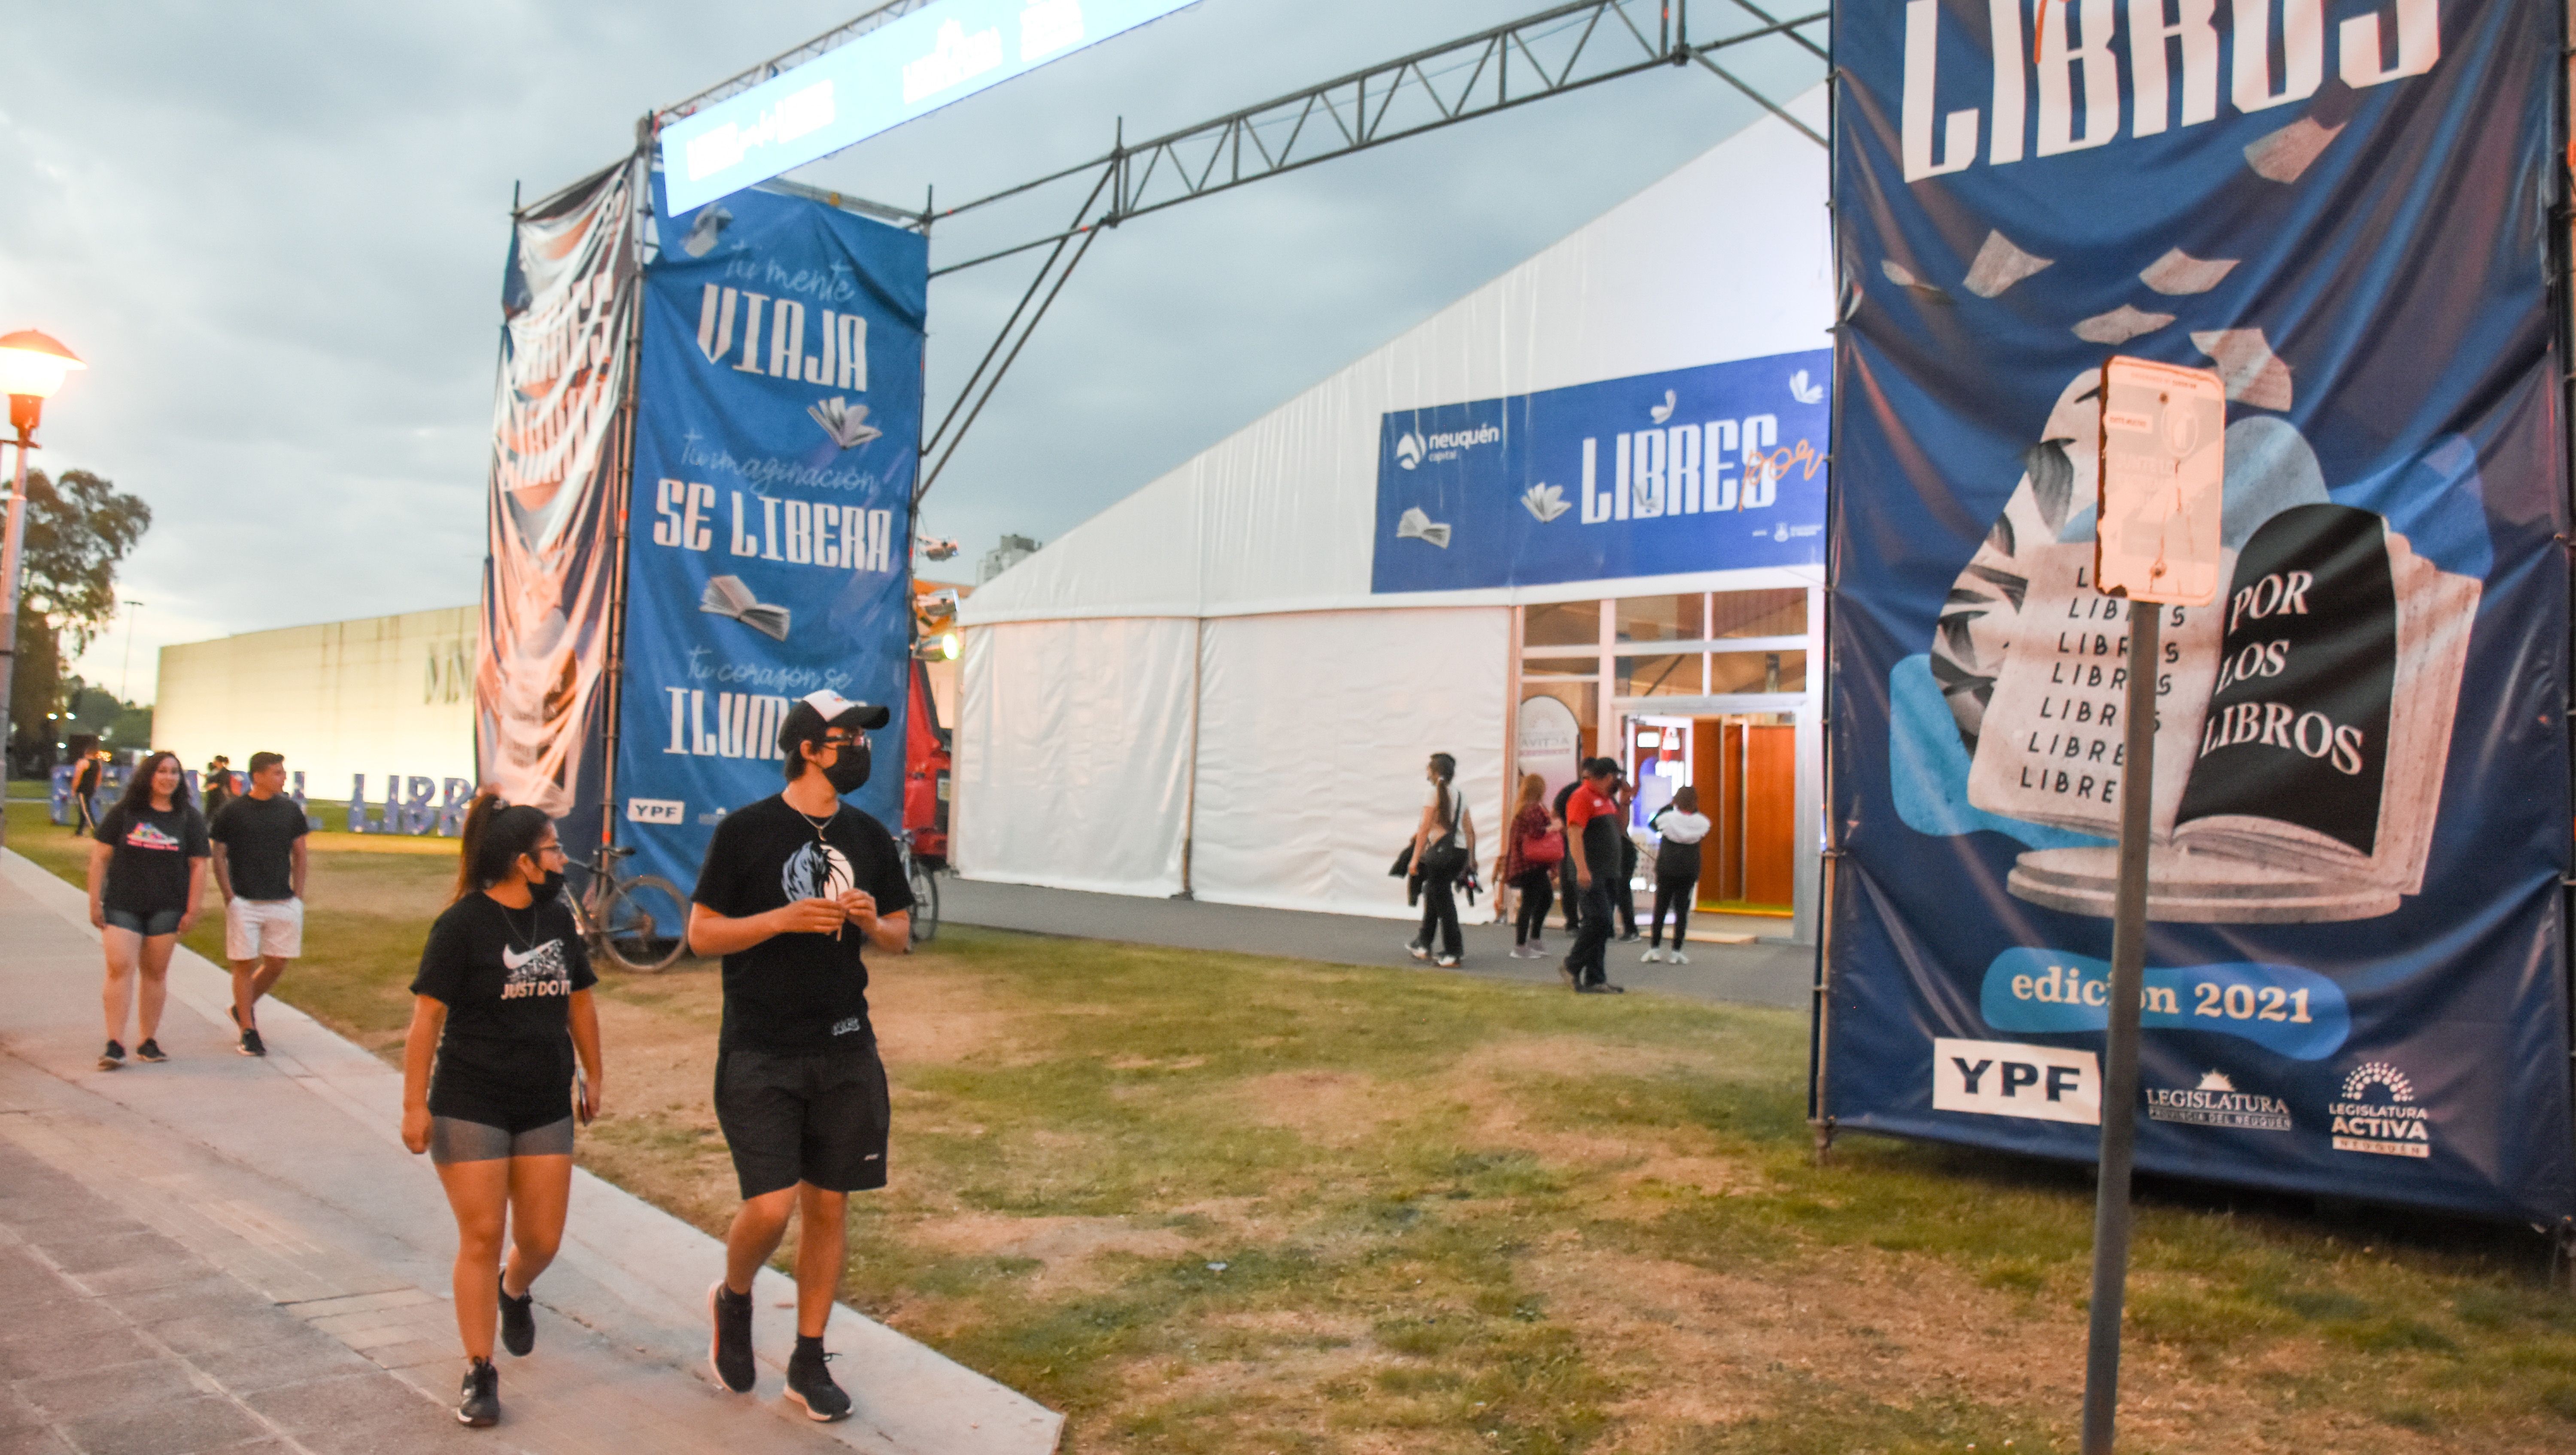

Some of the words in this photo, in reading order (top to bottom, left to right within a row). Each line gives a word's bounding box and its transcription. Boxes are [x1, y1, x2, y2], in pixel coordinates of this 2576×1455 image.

[766, 257, 855, 302] mente
[697, 282, 867, 392] VIAJA
[681, 427, 707, 466] tu
[1428, 421, 1500, 450] neuquén
[1581, 413, 1777, 524] LIBRES
[1738, 438, 1824, 512] por
[653, 477, 716, 552] SE
[731, 491, 892, 573] LIBERA
[2068, 597, 2184, 627] LIBS
[2228, 570, 2313, 637] POR
[2058, 631, 2179, 664] LIBRS
[687, 644, 716, 679] tu
[824, 668, 852, 690] se
[2051, 662, 2172, 695] LIBRS
[2215, 640, 2290, 696] LOS
[2028, 732, 2124, 766] LIBRE
[2200, 702, 2362, 775] LIBROS
[2020, 766, 2116, 803] LIBRE
[348, 773, 473, 837] LIBR
[635, 805, 677, 818] YPF
[501, 982, 536, 1000] JUST
[538, 980, 559, 996] DO
[2011, 965, 2180, 1014] edicn
[2194, 982, 2313, 1023] 2021
[1950, 1056, 2080, 1102] YPF
[2147, 1088, 2289, 1115] LEGISLATURA
[2209, 1113, 2229, 1124] DEL
[2329, 1103, 2428, 1120] LEGISLATURA
[2331, 1116, 2428, 1141] ACTIVA
